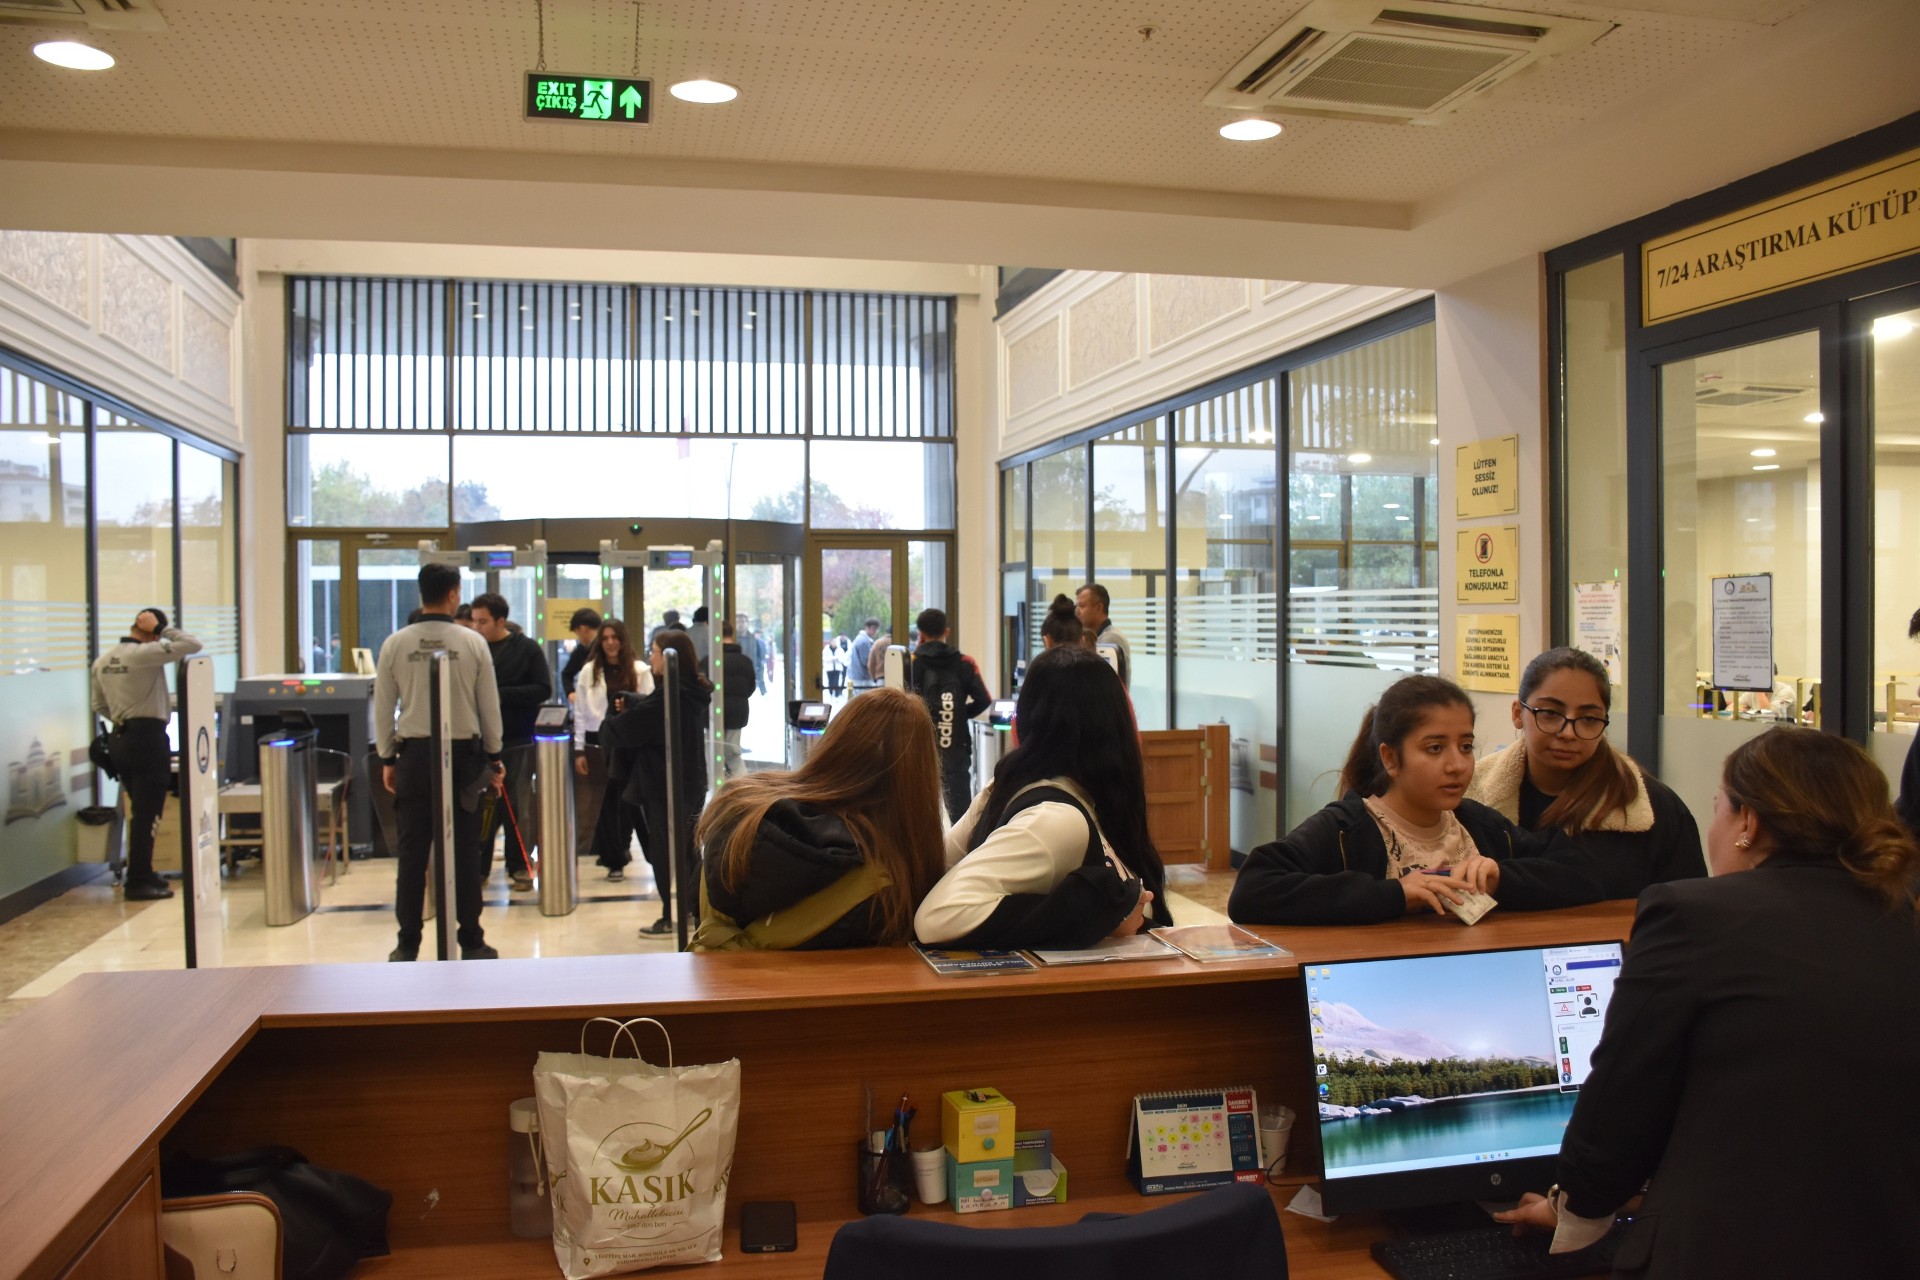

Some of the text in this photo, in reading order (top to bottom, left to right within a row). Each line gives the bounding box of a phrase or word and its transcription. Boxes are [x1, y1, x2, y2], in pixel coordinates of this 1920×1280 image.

[537, 81, 577, 96] EXIT
[535, 94, 577, 114] ÇIKIŞ
[1657, 188, 1920, 289] 7/24 ARAŞTIRMA KÜTÜP
[1474, 458, 1496, 470] LÜTFEN
[1474, 470, 1496, 482] SESSİZ
[1472, 484, 1498, 496] OLUNUZ!
[1469, 568, 1504, 578] TELEFONLA
[1464, 581, 1509, 592] KONUŞULMAZ!
[937, 692, 954, 749] adidas
[589, 1167, 695, 1209] KAŞIK
[608, 1208, 684, 1221] Muhallebicisi
